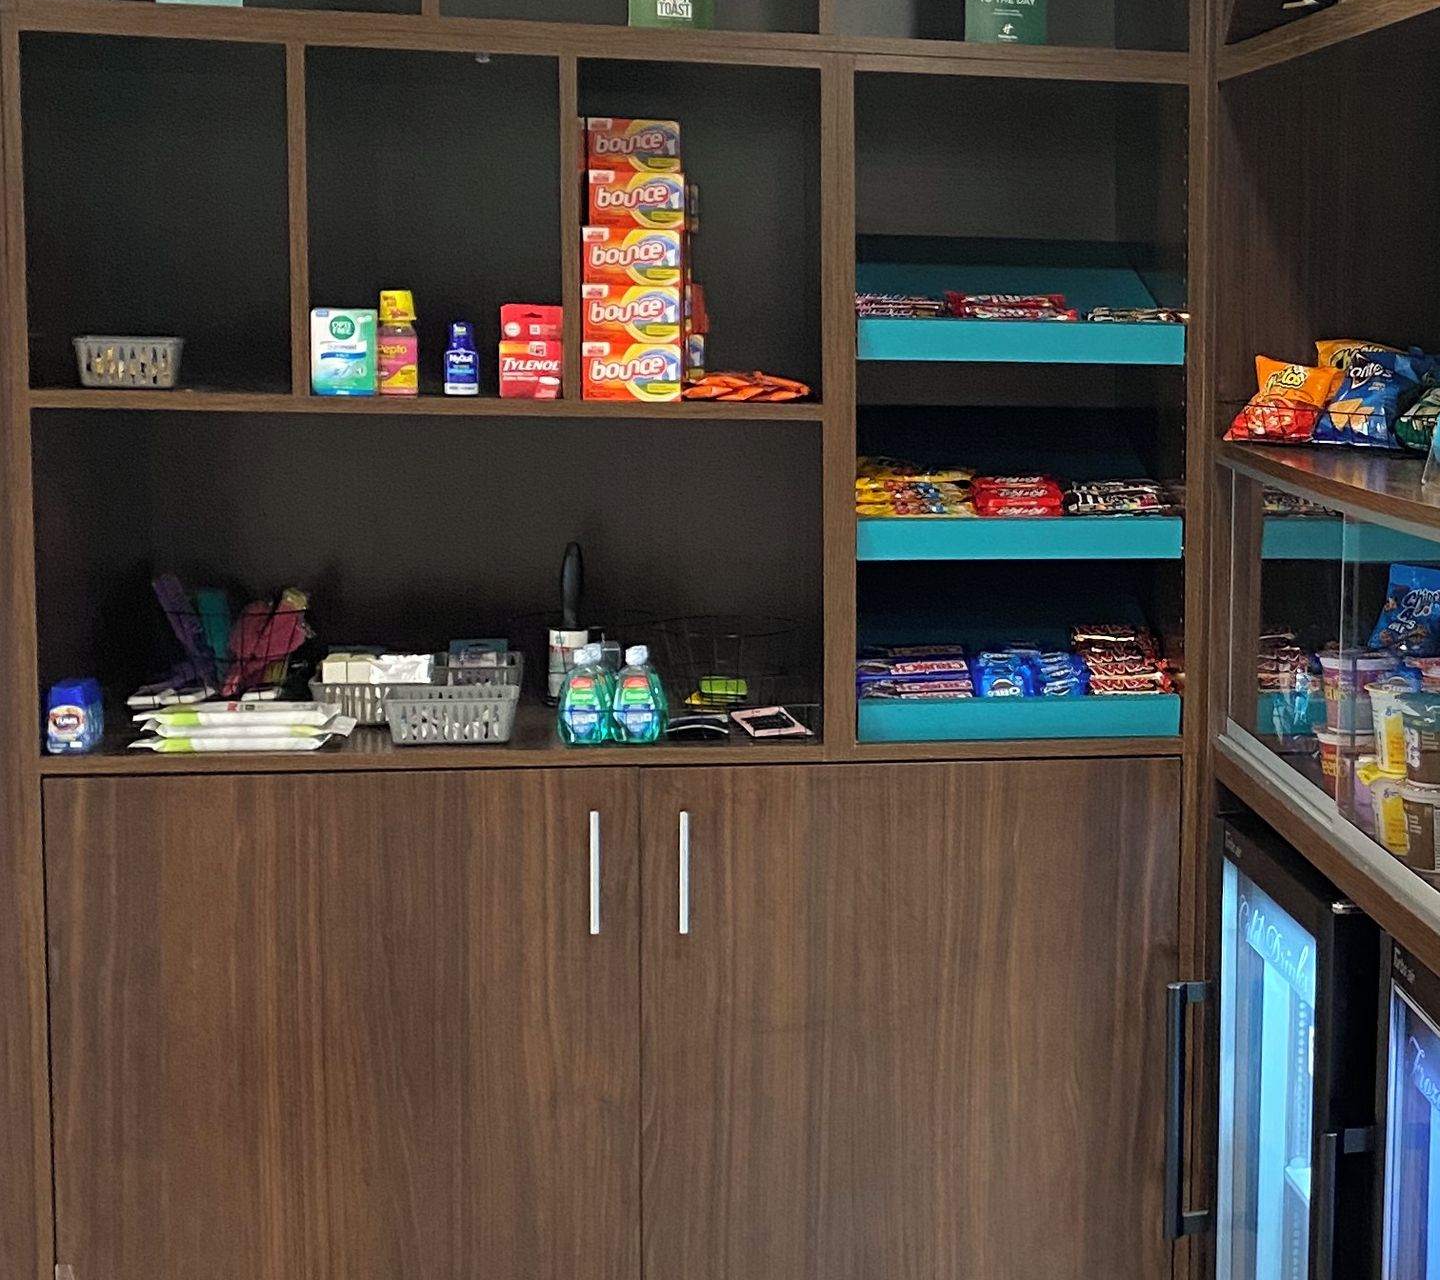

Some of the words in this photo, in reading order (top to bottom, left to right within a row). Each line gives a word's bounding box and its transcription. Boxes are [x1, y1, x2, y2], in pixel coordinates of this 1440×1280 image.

[659, 1, 690, 17] TOAST
[596, 133, 663, 154] bounce
[597, 185, 668, 208] bounce
[592, 243, 664, 266] bounce
[590, 299, 663, 323] bounce
[379, 345, 407, 354] Pepto
[449, 355, 473, 364] NyQuil
[503, 358, 559, 371] TYLENOL
[591, 357, 665, 381] bounce
